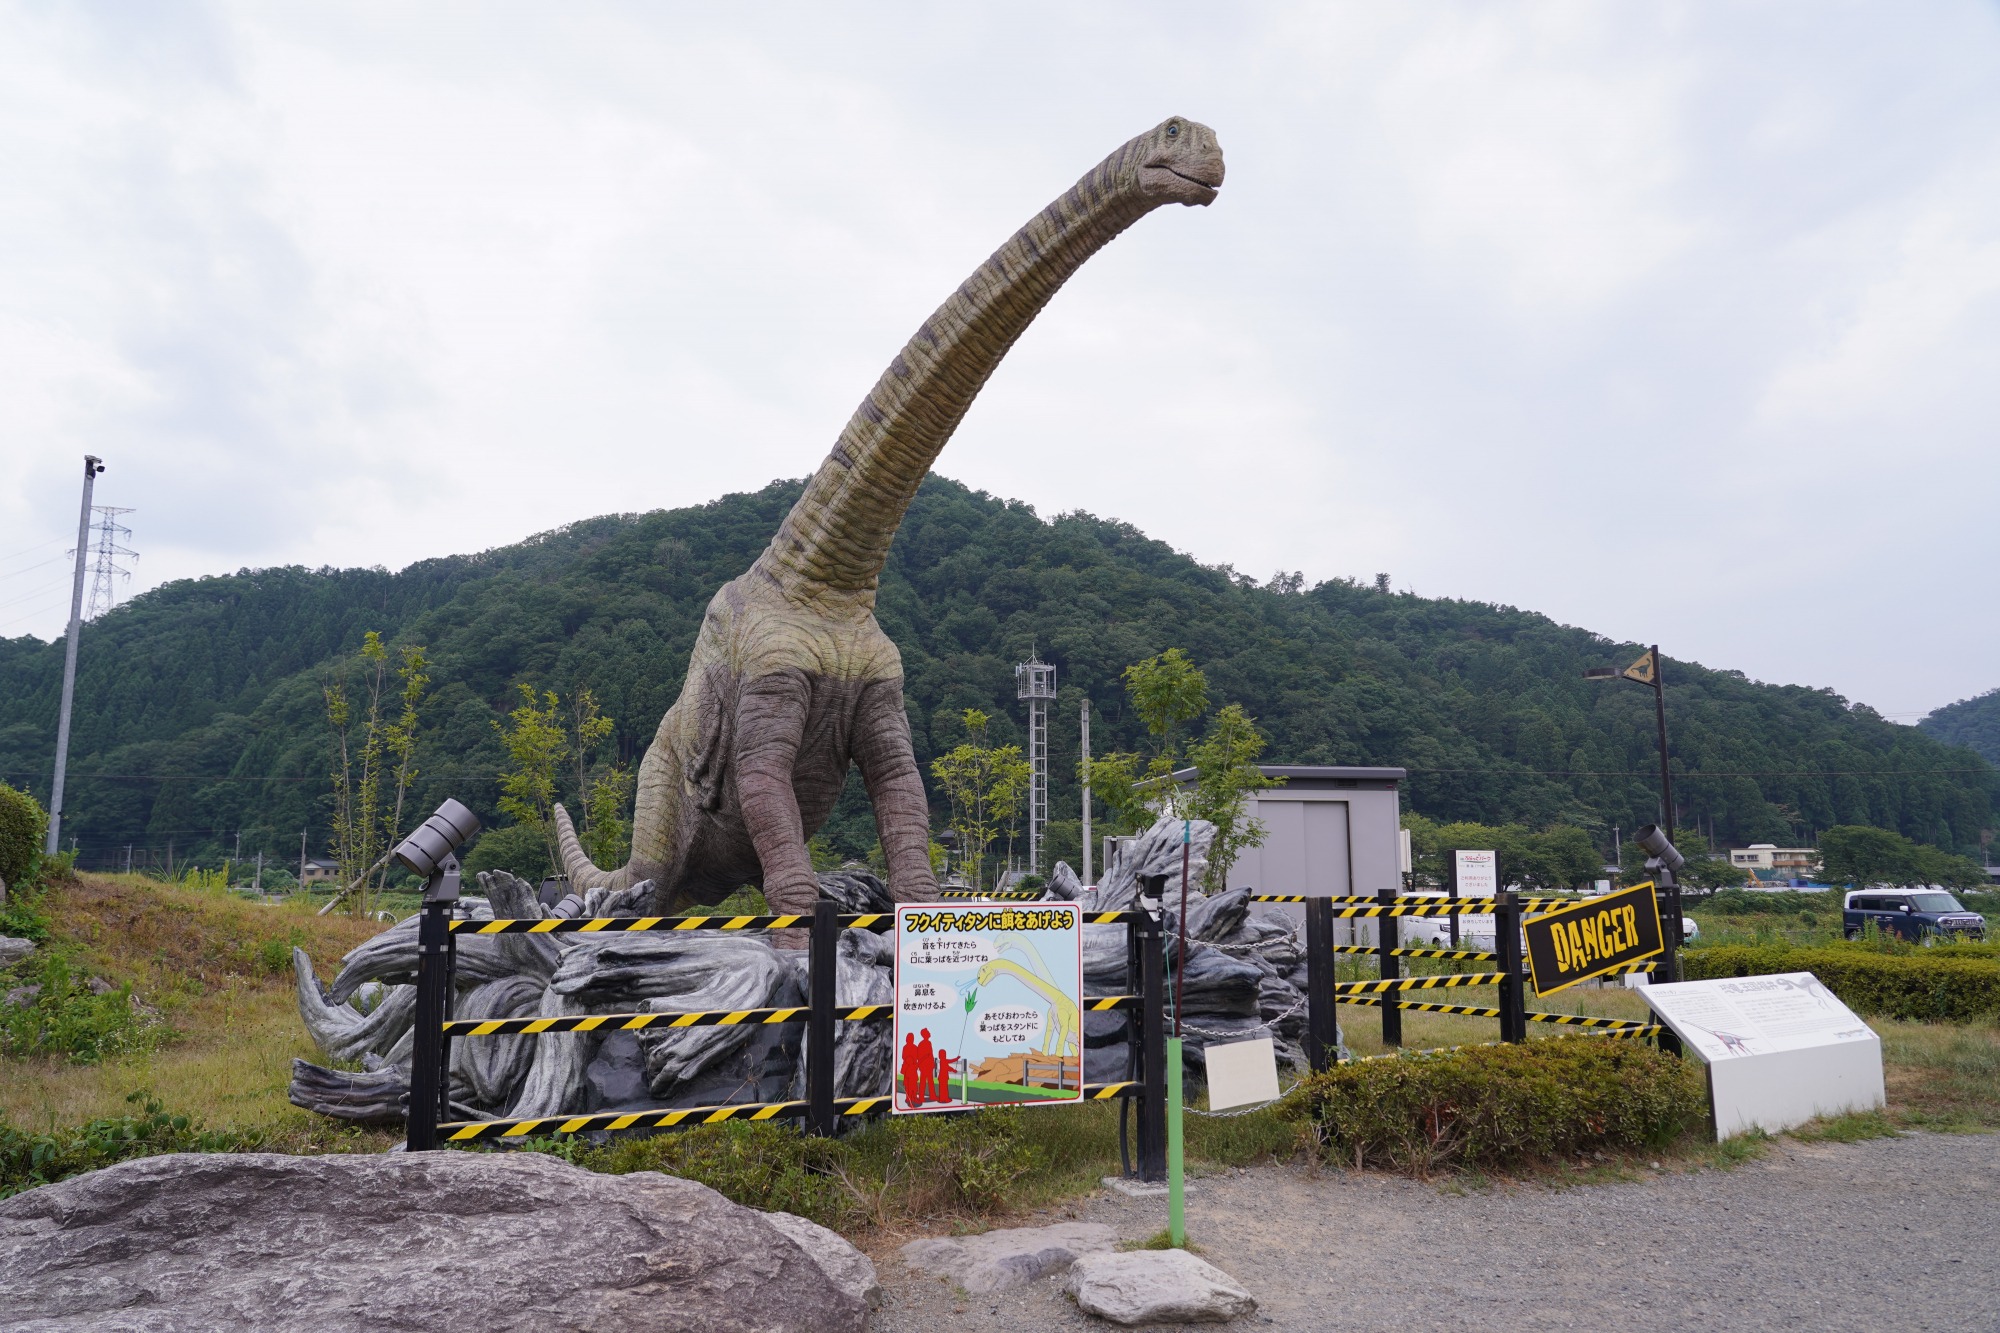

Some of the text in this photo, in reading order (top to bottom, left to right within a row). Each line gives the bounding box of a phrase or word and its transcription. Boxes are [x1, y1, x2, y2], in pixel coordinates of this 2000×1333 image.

[905, 909, 1074, 933] フクイティタンに餌をあげよう
[1550, 904, 1639, 973] DANGER
[922, 942, 977, 950] 首を下げてきたら
[910, 955, 989, 964] 口に葉っぱを近づけてね
[914, 988, 936, 996] 鼻息を
[903, 1002, 946, 1011] 吹きかけるよ
[984, 1011, 1038, 1021] あそびおわったら
[979, 1022, 1038, 1032] 葉っぱをスタンドに
[992, 1034, 1026, 1043] もどしてね
